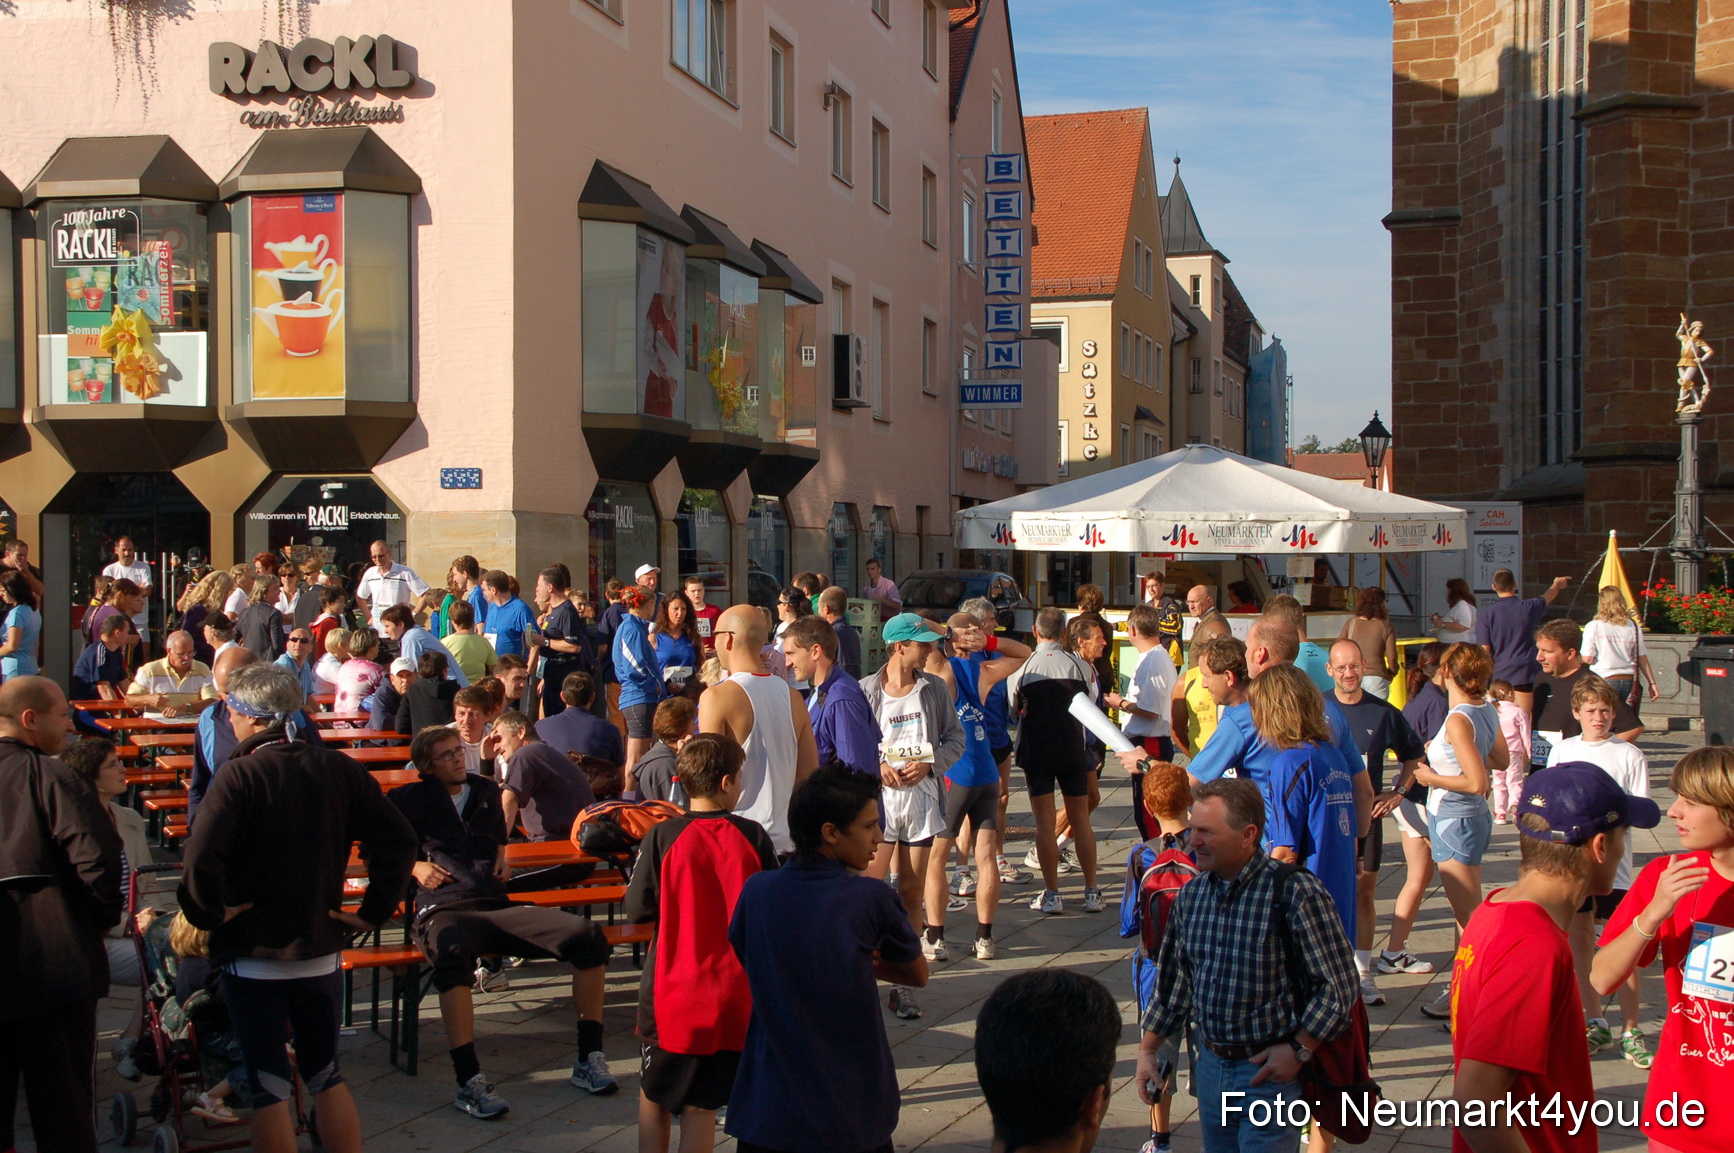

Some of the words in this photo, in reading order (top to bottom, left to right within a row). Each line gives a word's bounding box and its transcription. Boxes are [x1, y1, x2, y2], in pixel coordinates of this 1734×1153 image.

[208, 33, 412, 95] RACKL
[241, 109, 280, 128] am
[62, 210, 86, 226] 100
[86, 207, 126, 225] Jahre
[57, 228, 117, 259] RACKL
[993, 160, 1013, 363] BETTEN
[964, 384, 1018, 401] WIMMER
[249, 512, 296, 520] Willkommen
[296, 511, 307, 520] im
[308, 505, 349, 526] RACKL
[615, 504, 634, 529] RACKL
[1486, 510, 1505, 519] CAH
[1021, 523, 1073, 537] NEUMARKTER
[1207, 523, 1273, 539] NEUMARKTER
[1391, 523, 1428, 538] NEUMARKTER
[888, 711, 922, 725] HUBER
[898, 745, 922, 758] 213
[1535, 745, 1552, 757] 237
